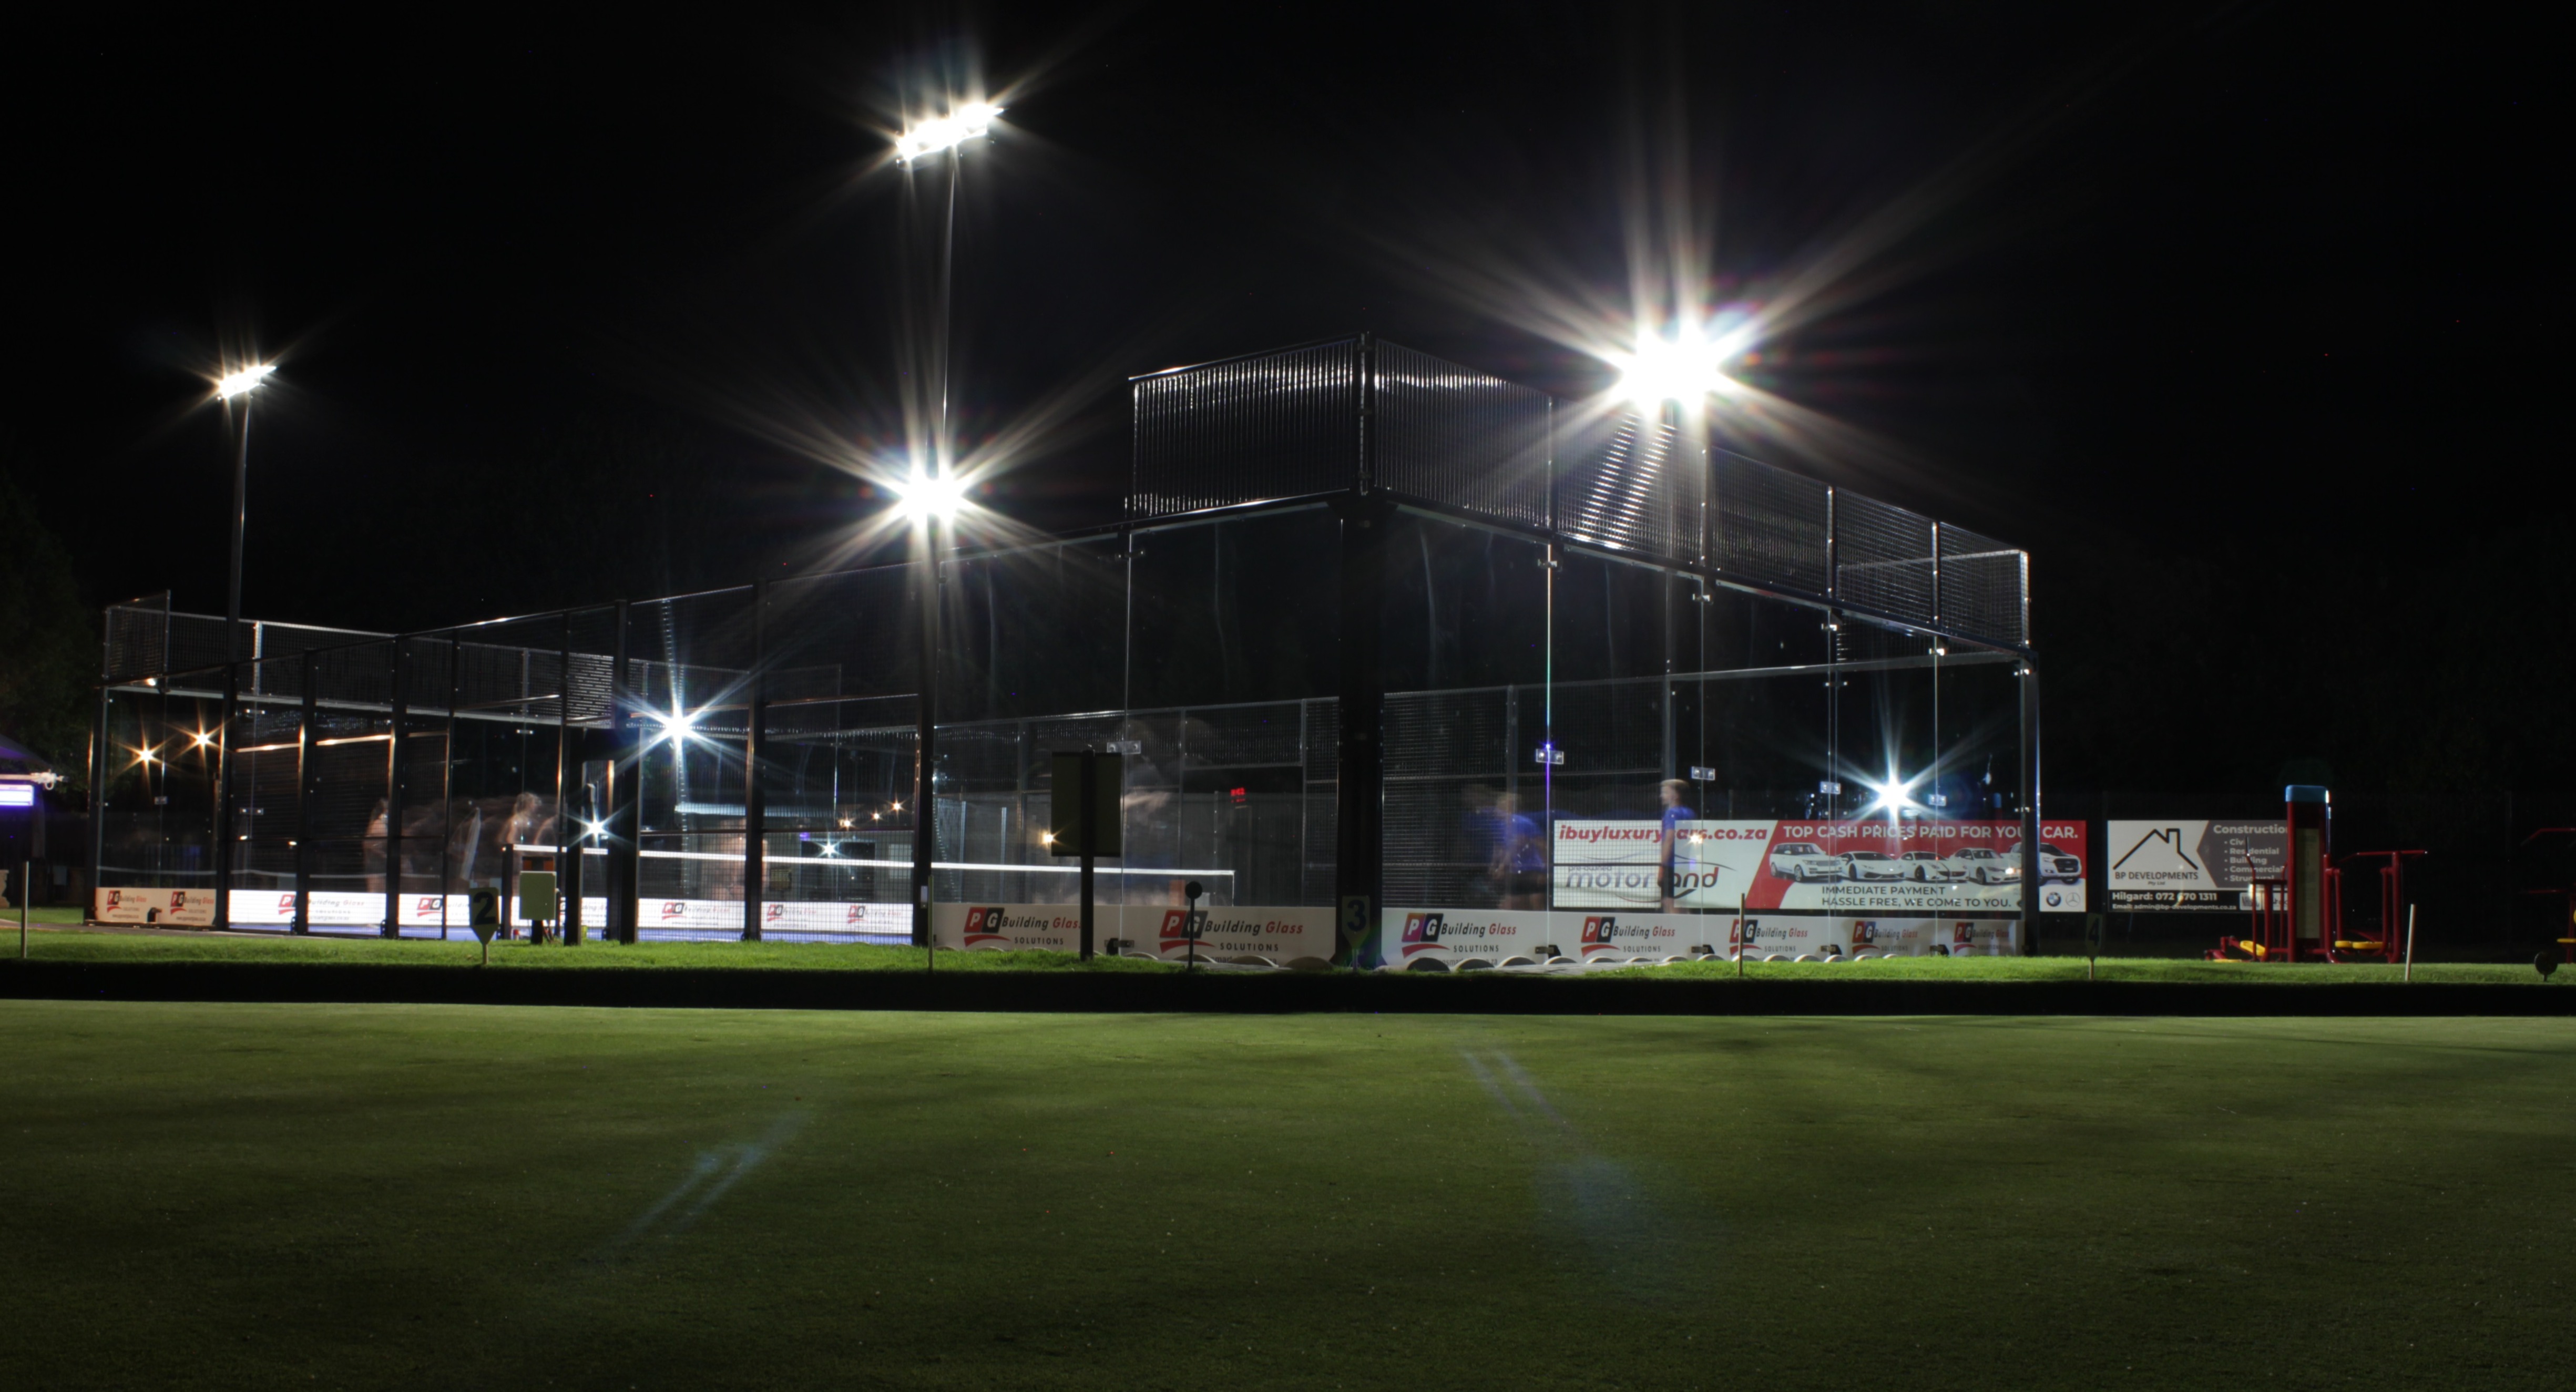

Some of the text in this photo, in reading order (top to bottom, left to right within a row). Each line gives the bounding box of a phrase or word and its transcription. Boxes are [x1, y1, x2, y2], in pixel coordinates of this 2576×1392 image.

[1559, 825, 1767, 842] ibuyluxuryars.co.za
[1783, 826, 2078, 838] TOP CASH PRICES PAID FOR YOU CAR.
[2213, 824, 2288, 834] Constructio
[1566, 867, 1720, 888] motorand
[1822, 886, 1946, 895] IMMEDIATE PAYMENT
[1822, 898, 2011, 907] HASSLE FREE, WE COME TO YOU.
[2112, 893, 2153, 902] Hilgard:
[474, 892, 496, 925] 2
[1346, 899, 1366, 932] 3
[1002, 916, 1049, 930] Building
[1052, 917, 1081, 928] Glas
[1205, 919, 1261, 936] Building
[1266, 920, 1303, 934] Glass
[1441, 923, 1486, 937] Building
[1489, 923, 1517, 935] Glass
[1613, 925, 1650, 939] Building
[1652, 926, 1675, 937] Glass
[1756, 927, 1787, 939] Building
[1788, 928, 1808, 937] Glass
[1874, 929, 1900, 939] Building
[1902, 929, 1918, 938] Glass
[2089, 917, 2100, 946] 4
[1014, 936, 1064, 945] SOLUTIONS
[1220, 942, 1279, 951] SOLUTIONS
[1454, 945, 1499, 953] SOLUTIONS
